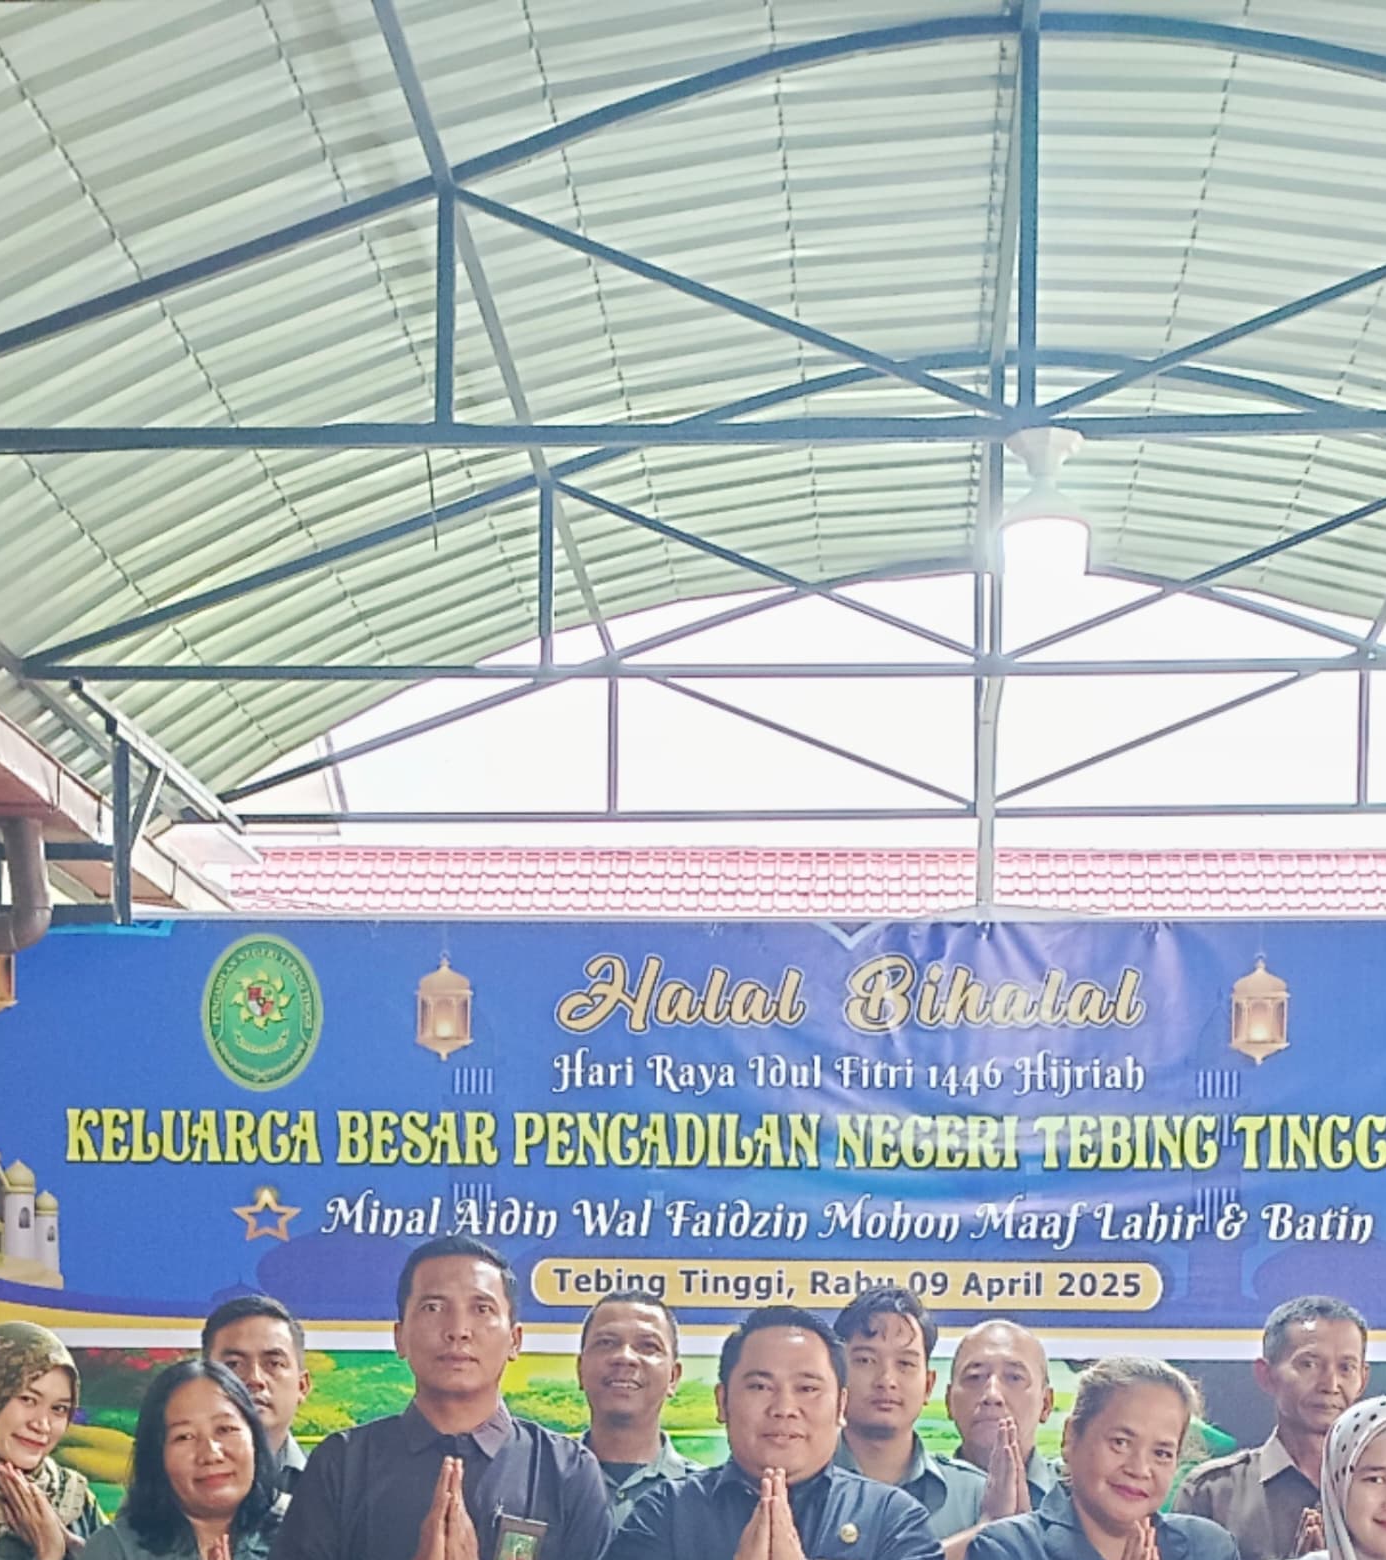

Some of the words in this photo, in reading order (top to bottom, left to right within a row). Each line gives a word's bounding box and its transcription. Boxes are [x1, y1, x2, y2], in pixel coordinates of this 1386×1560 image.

[557, 954, 806, 1032] Halal
[844, 954, 1144, 1032] Bihalal
[552, 1048, 635, 1093] Hari
[646, 1054, 736, 1096] Raya
[748, 1054, 821, 1088] Idul
[834, 1056, 914, 1089] Fitri
[927, 1058, 1003, 1096] 1446
[1013, 1050, 1145, 1098] Hijriah
[66, 1108, 322, 1164] KELUARGA
[336, 1110, 500, 1166] BESAR
[513, 1112, 821, 1168] PENGADILAN
[835, 1113, 1020, 1169] NEGERI
[1033, 1114, 1220, 1170] TEBING
[321, 1189, 441, 1237] Minal
[446, 1196, 558, 1239] Aidin
[572, 1199, 652, 1237] Wal
[665, 1200, 809, 1240] Faidzin
[818, 1194, 960, 1241] Mohon
[970, 1196, 1088, 1250] Maaf
[1093, 1203, 1204, 1242] Lahir
[1216, 1203, 1248, 1241] &
[1261, 1204, 1374, 1243] Batin
[552, 1268, 666, 1298] Tebing
[679, 1269, 795, 1299] Tinggi,
[909, 1271, 949, 1296] 09
[962, 1271, 1042, 1301] April
[1058, 1273, 1141, 1297] 2025
